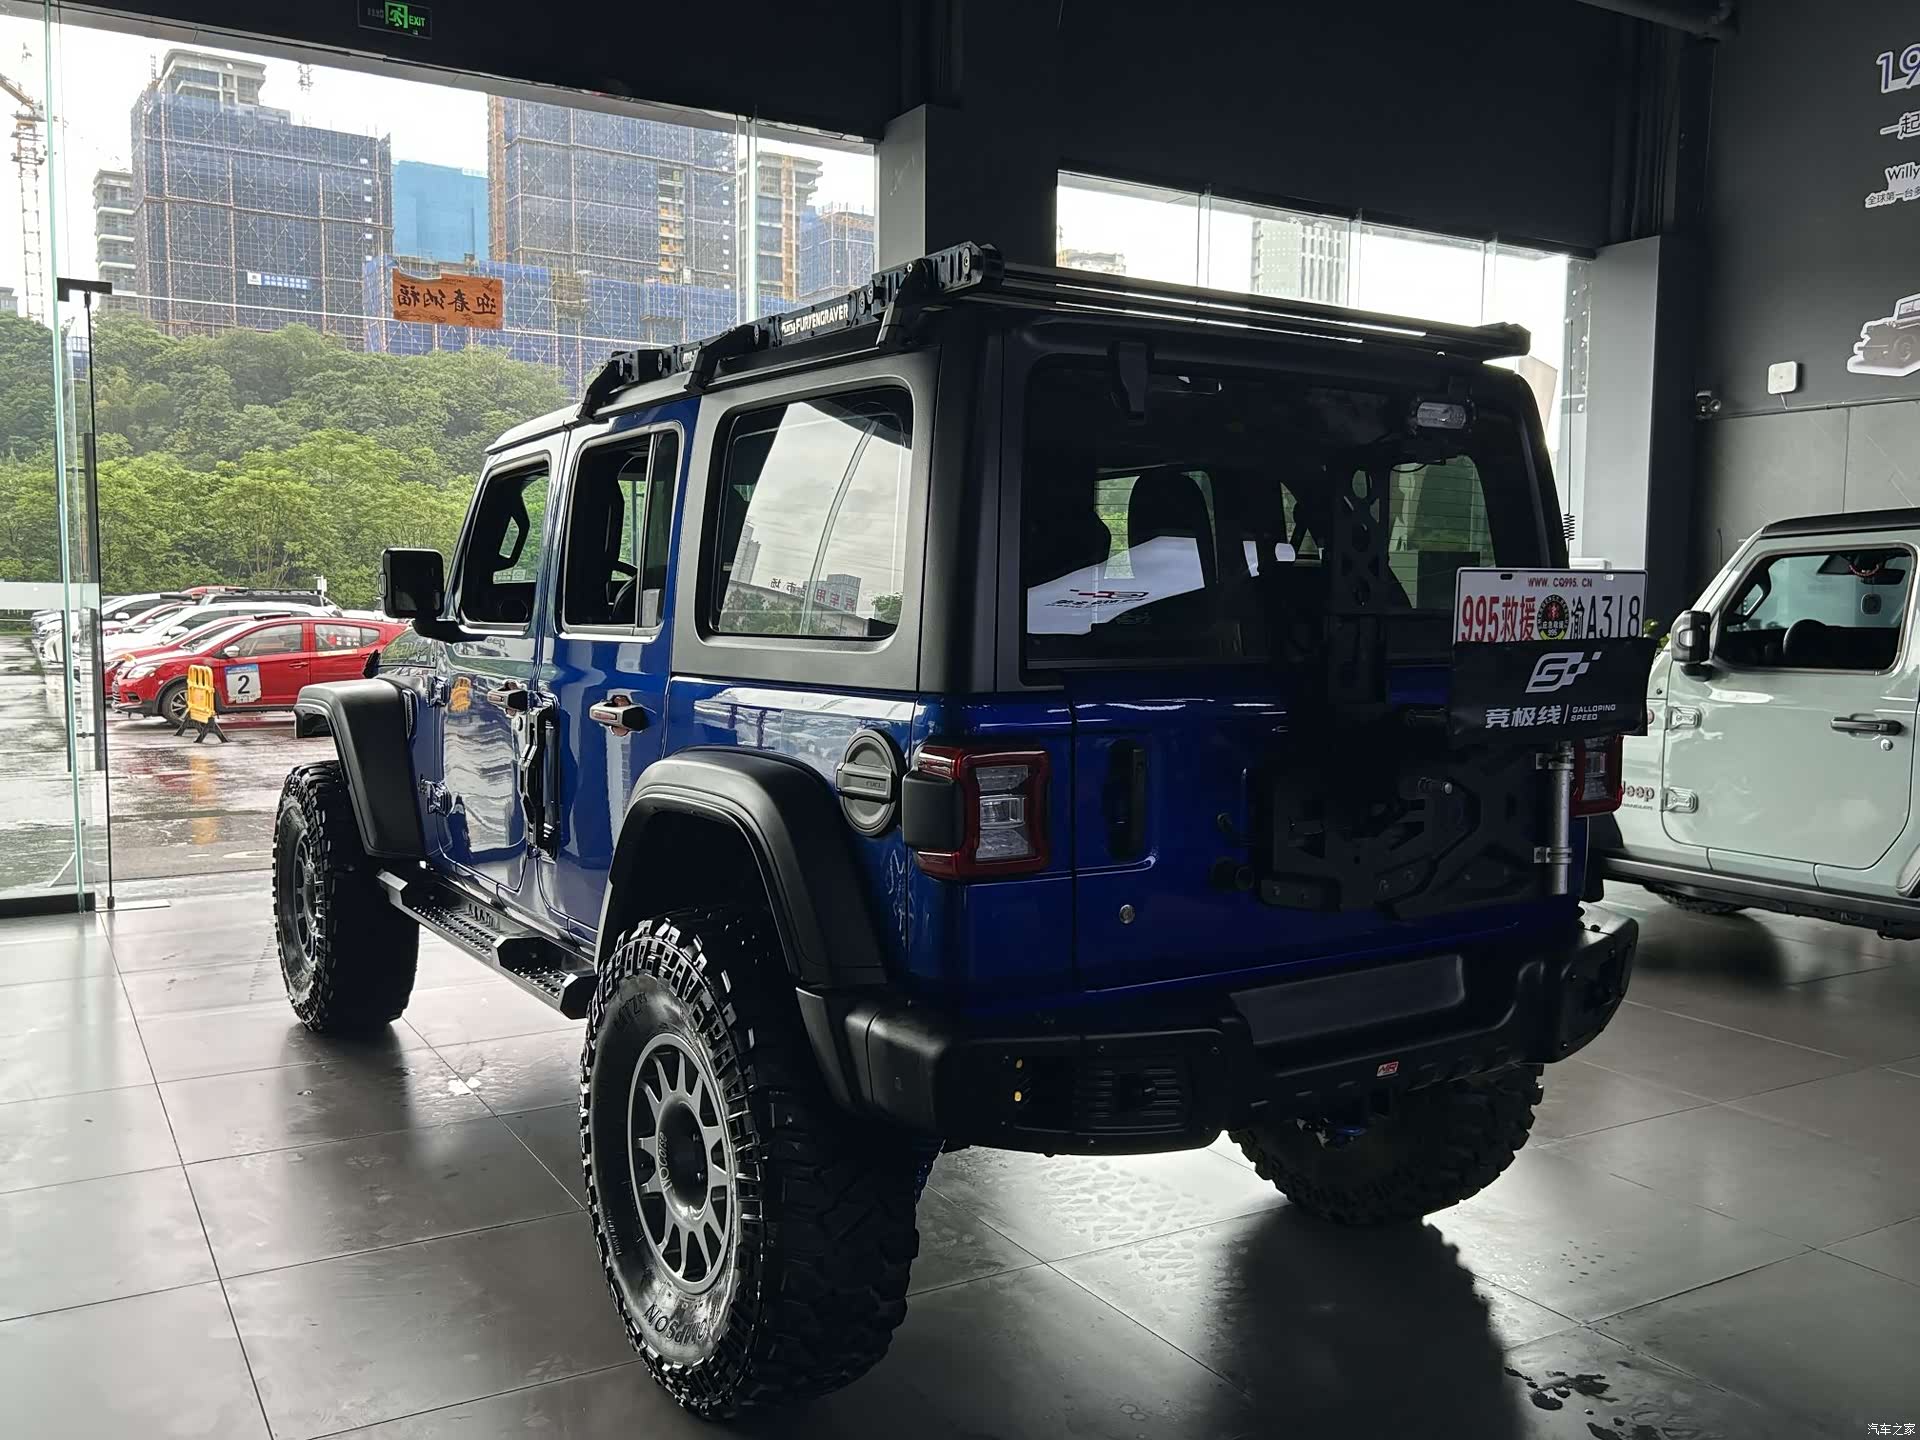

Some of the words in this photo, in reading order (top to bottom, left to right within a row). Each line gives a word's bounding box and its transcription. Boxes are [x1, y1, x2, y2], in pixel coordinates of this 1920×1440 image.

[409, 15, 426, 27] EXIT
[238, 674, 250, 694] 2
[1485, 704, 1562, 729] 竞极线
[1572, 703, 1616, 714] GALLOPING
[1570, 713, 1598, 722] SPEED
[1622, 780, 1655, 802] Jeep
